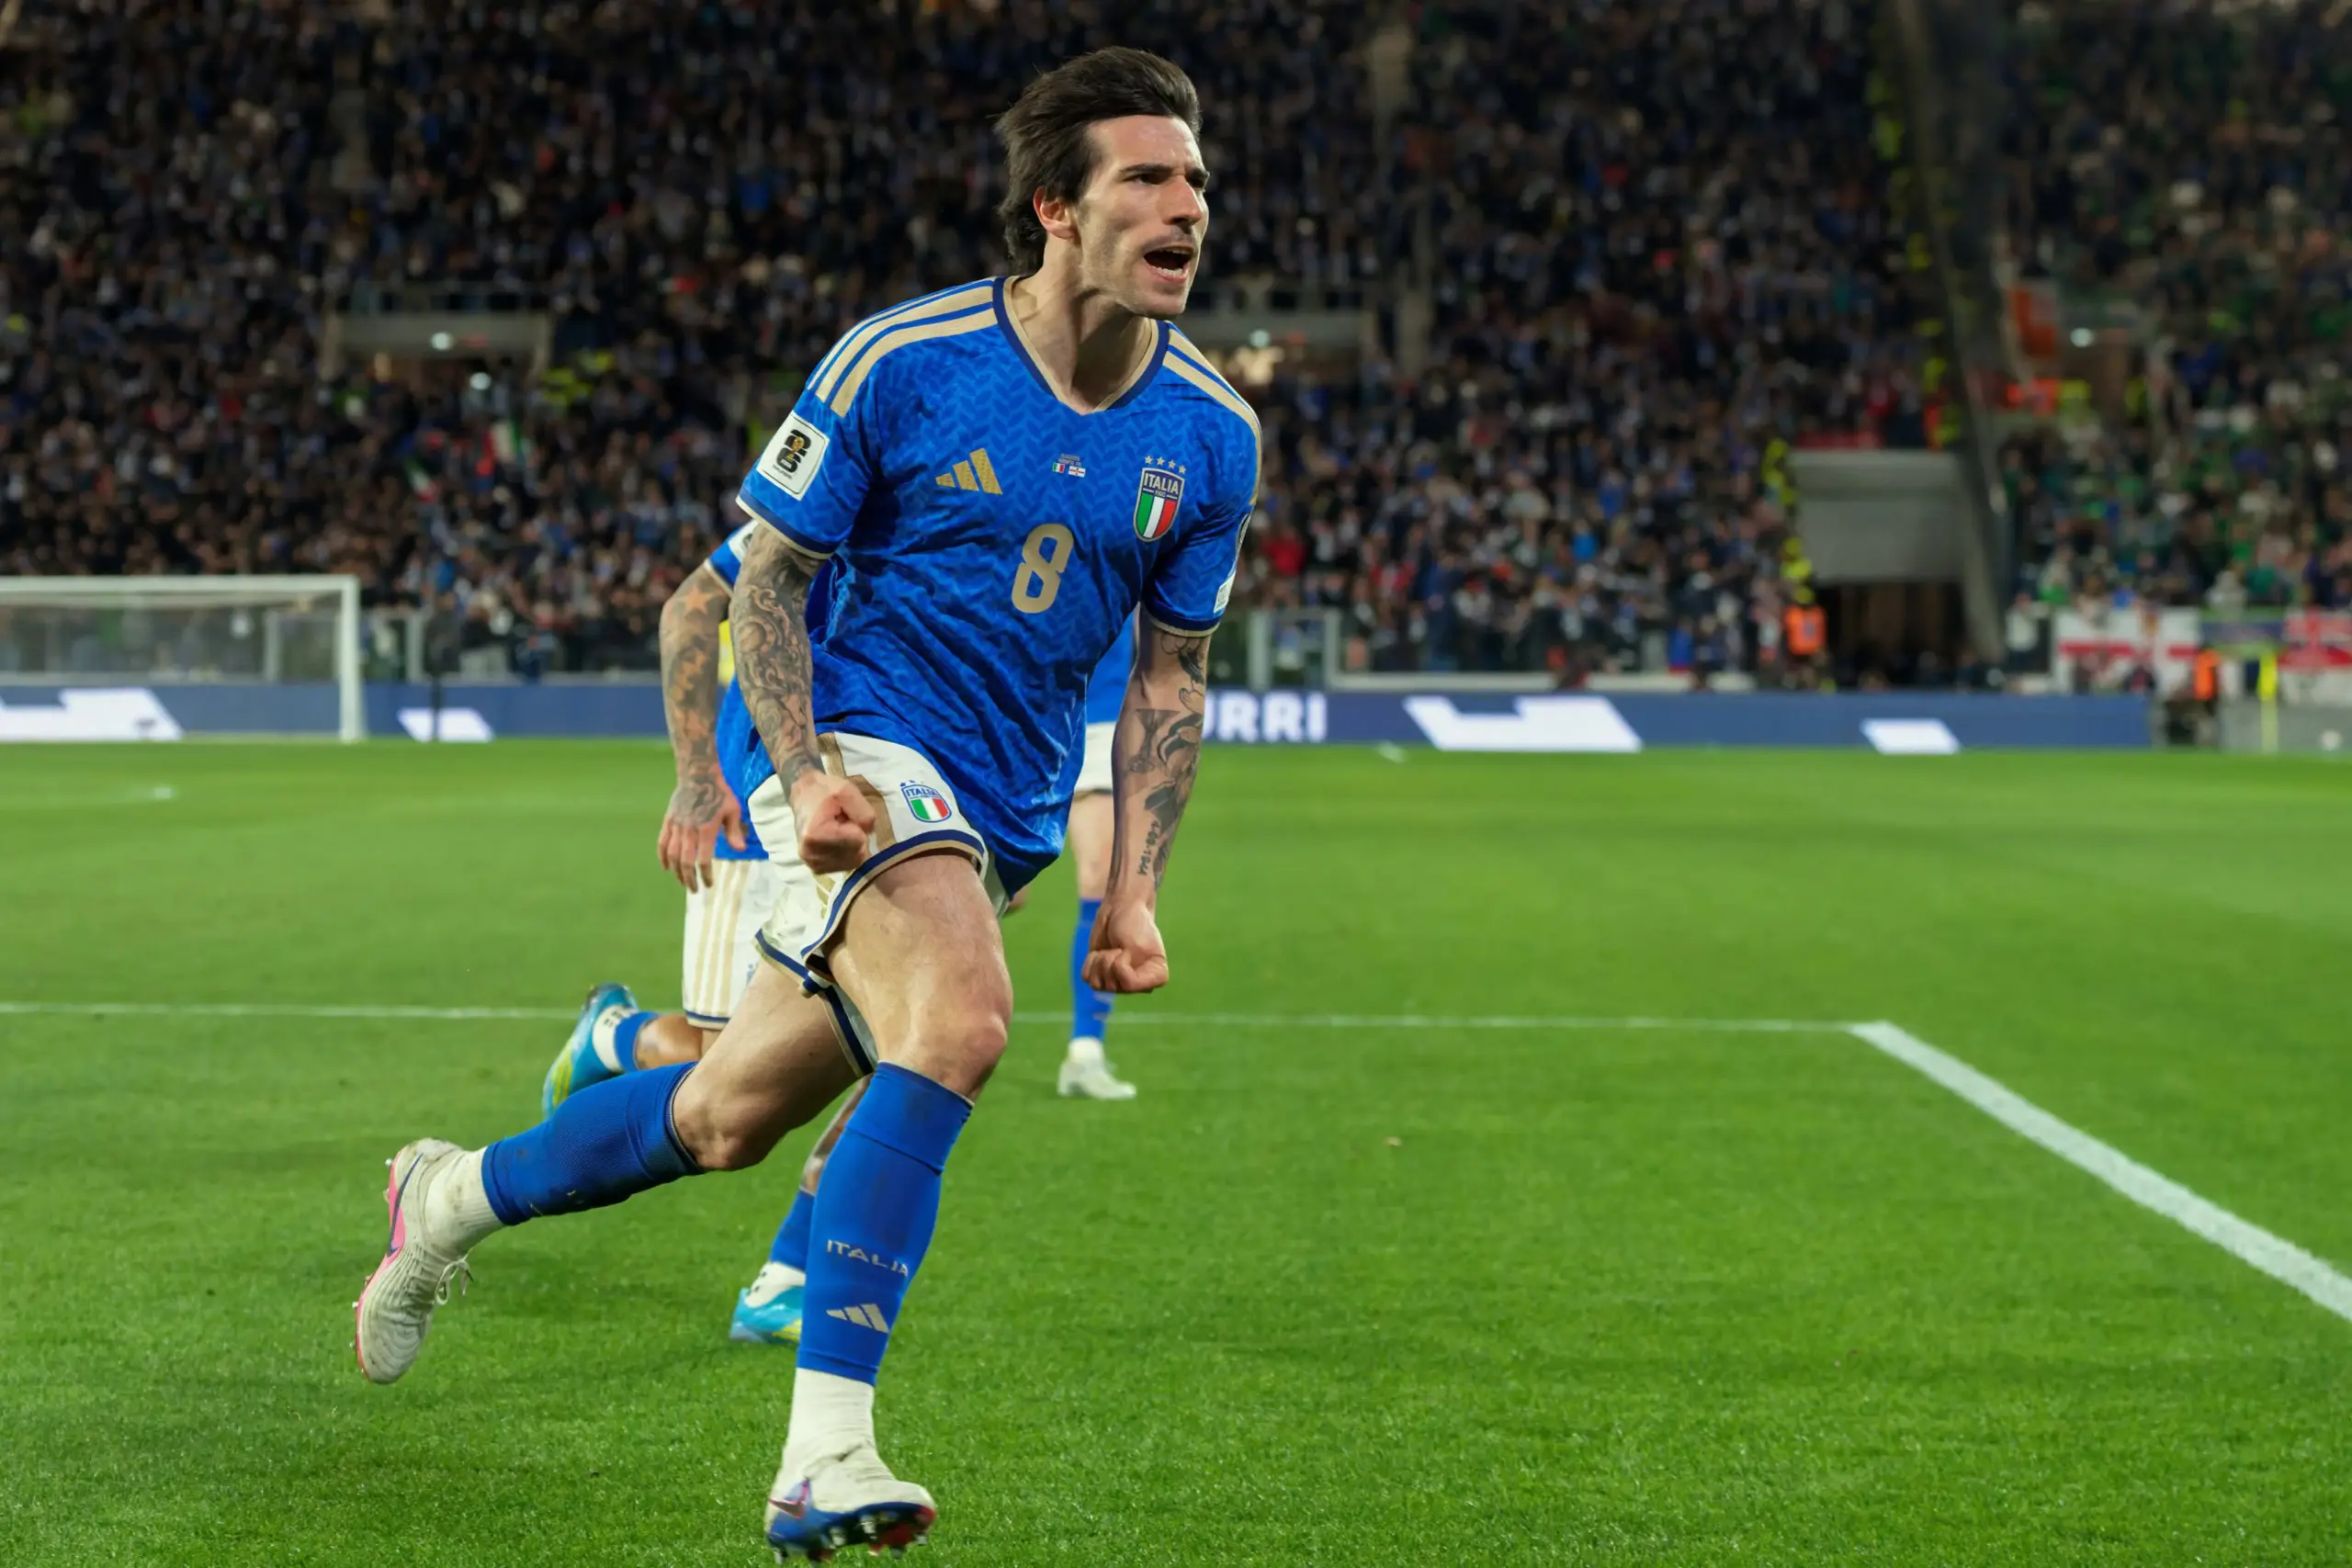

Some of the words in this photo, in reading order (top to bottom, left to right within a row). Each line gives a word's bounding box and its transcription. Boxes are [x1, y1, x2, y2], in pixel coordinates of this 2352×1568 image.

[1144, 473, 1179, 494] ITALIA
[1012, 524, 1074, 614] 8
[905, 788, 938, 796] ITALIA
[827, 1239, 909, 1277] ITALIA
